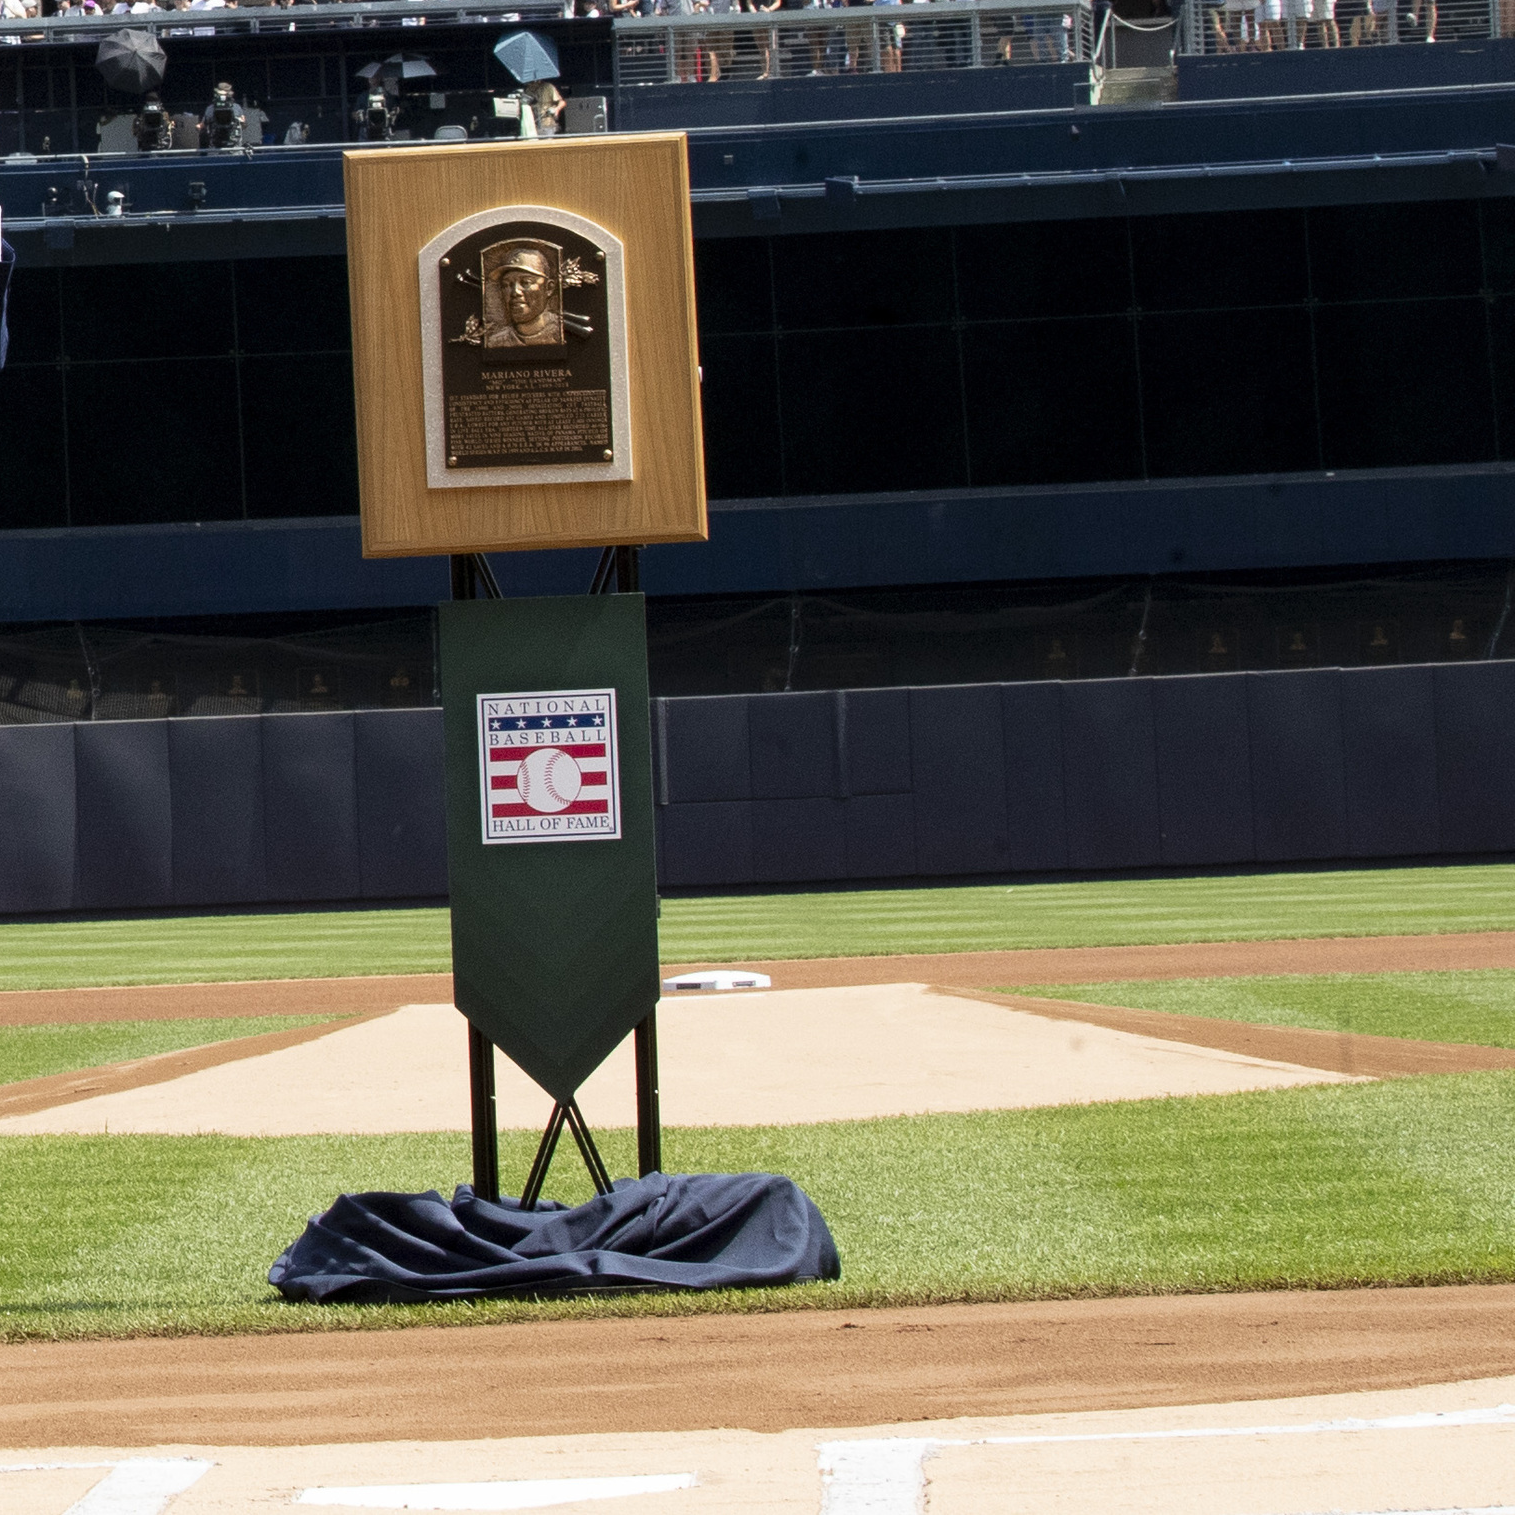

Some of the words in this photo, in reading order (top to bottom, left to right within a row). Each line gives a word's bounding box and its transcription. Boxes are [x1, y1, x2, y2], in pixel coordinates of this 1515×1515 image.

[482, 371, 530, 380] MARIANO
[533, 369, 572, 378] RIVERA
[488, 699, 605, 715] NATIONAL
[489, 729, 606, 746] BASEBALL
[492, 818, 535, 833] HALL
[540, 818, 561, 831] OF
[566, 815, 610, 830] FAME
